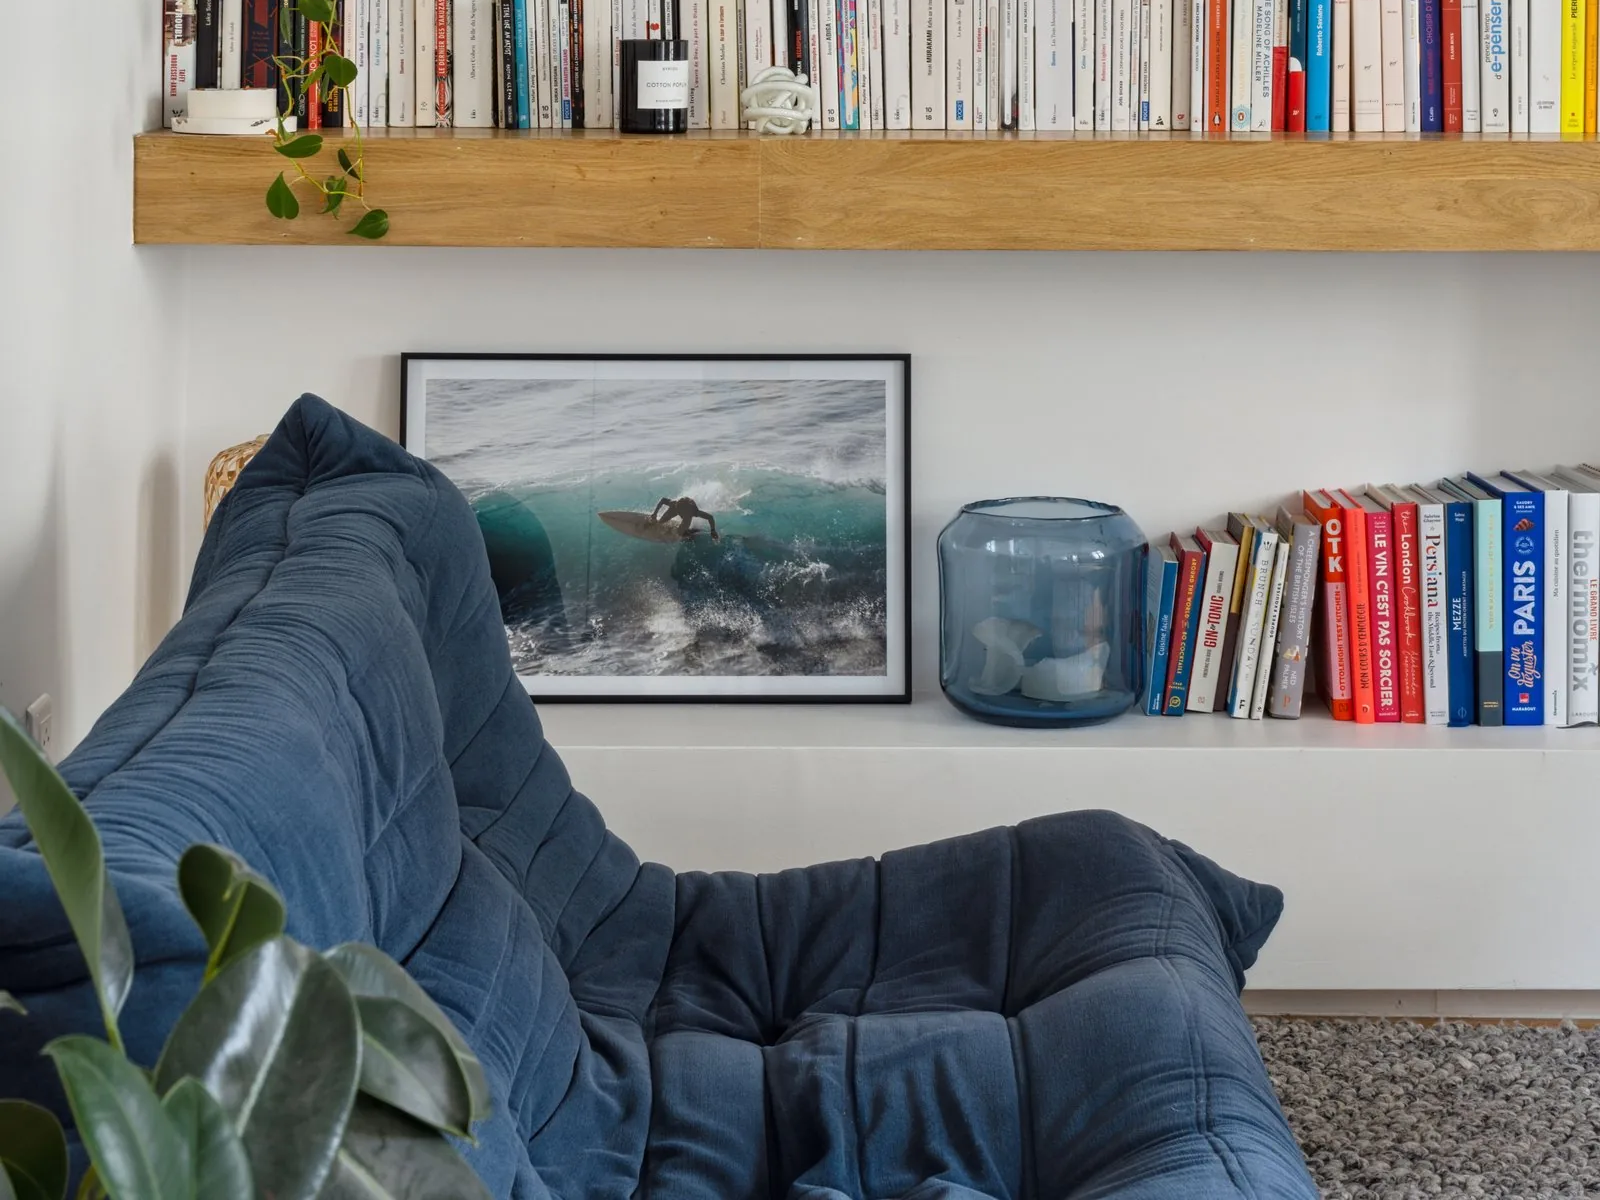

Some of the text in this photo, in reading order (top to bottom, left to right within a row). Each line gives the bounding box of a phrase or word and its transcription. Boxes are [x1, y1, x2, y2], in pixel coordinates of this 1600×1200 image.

[174, 8, 184, 45] TROUBLE
[437, 27, 445, 39] DES
[1255, 5, 1263, 49] MADELINE
[1316, 4, 1324, 30] Saviano
[1425, 14, 1434, 45] CHOISIR
[437, 39, 445, 66] DERNIER
[1263, 38, 1271, 49] OF
[1315, 30, 1324, 56] Roberto
[178, 68, 186, 83] TAFFY
[1262, 54, 1270, 98] ACHILLES
[542, 112, 549, 120] 18
[1325, 518, 1344, 573] OTK
[1552, 529, 1560, 558] quotidien
[1189, 557, 1197, 584] AROUND
[1299, 538, 1314, 606] CHEESEMONGER'S
[1400, 510, 1417, 646] the London Cookbook
[1425, 534, 1442, 608] Persiana
[1553, 558, 1559, 566] au
[1255, 559, 1269, 606] BRUNCH
[1288, 545, 1305, 624] OF THE BRITISH ISLES
[1512, 560, 1536, 635] PARIS
[1552, 588, 1559, 598] Ma
[1184, 597, 1192, 619] WORLD
[1204, 595, 1224, 648] GIN TONIC
[1269, 582, 1282, 638] SOUPES EXQUISES
[1296, 607, 1306, 640] HISTORY
[1374, 533, 1393, 707] LE VIN C'EST PAS SORCIER
[1433, 611, 1441, 636] Recipes
[1452, 597, 1462, 631] MEZZE
[1572, 530, 1596, 692] thermomix
[1589, 579, 1598, 641] LE GRAND LIVRE
[1158, 614, 1169, 656] Cuisine facile
[1334, 590, 1346, 692] OTTOLENGHI TEST KITCHEN
[1427, 622, 1435, 645] Middle
[1176, 642, 1186, 675] COCKTAILS
[1358, 648, 1369, 671] COURS
[1507, 646, 1521, 679] On va
[1516, 640, 1542, 688] déguster
[1281, 663, 1290, 690] PALMER
[1360, 672, 1370, 689] MON
